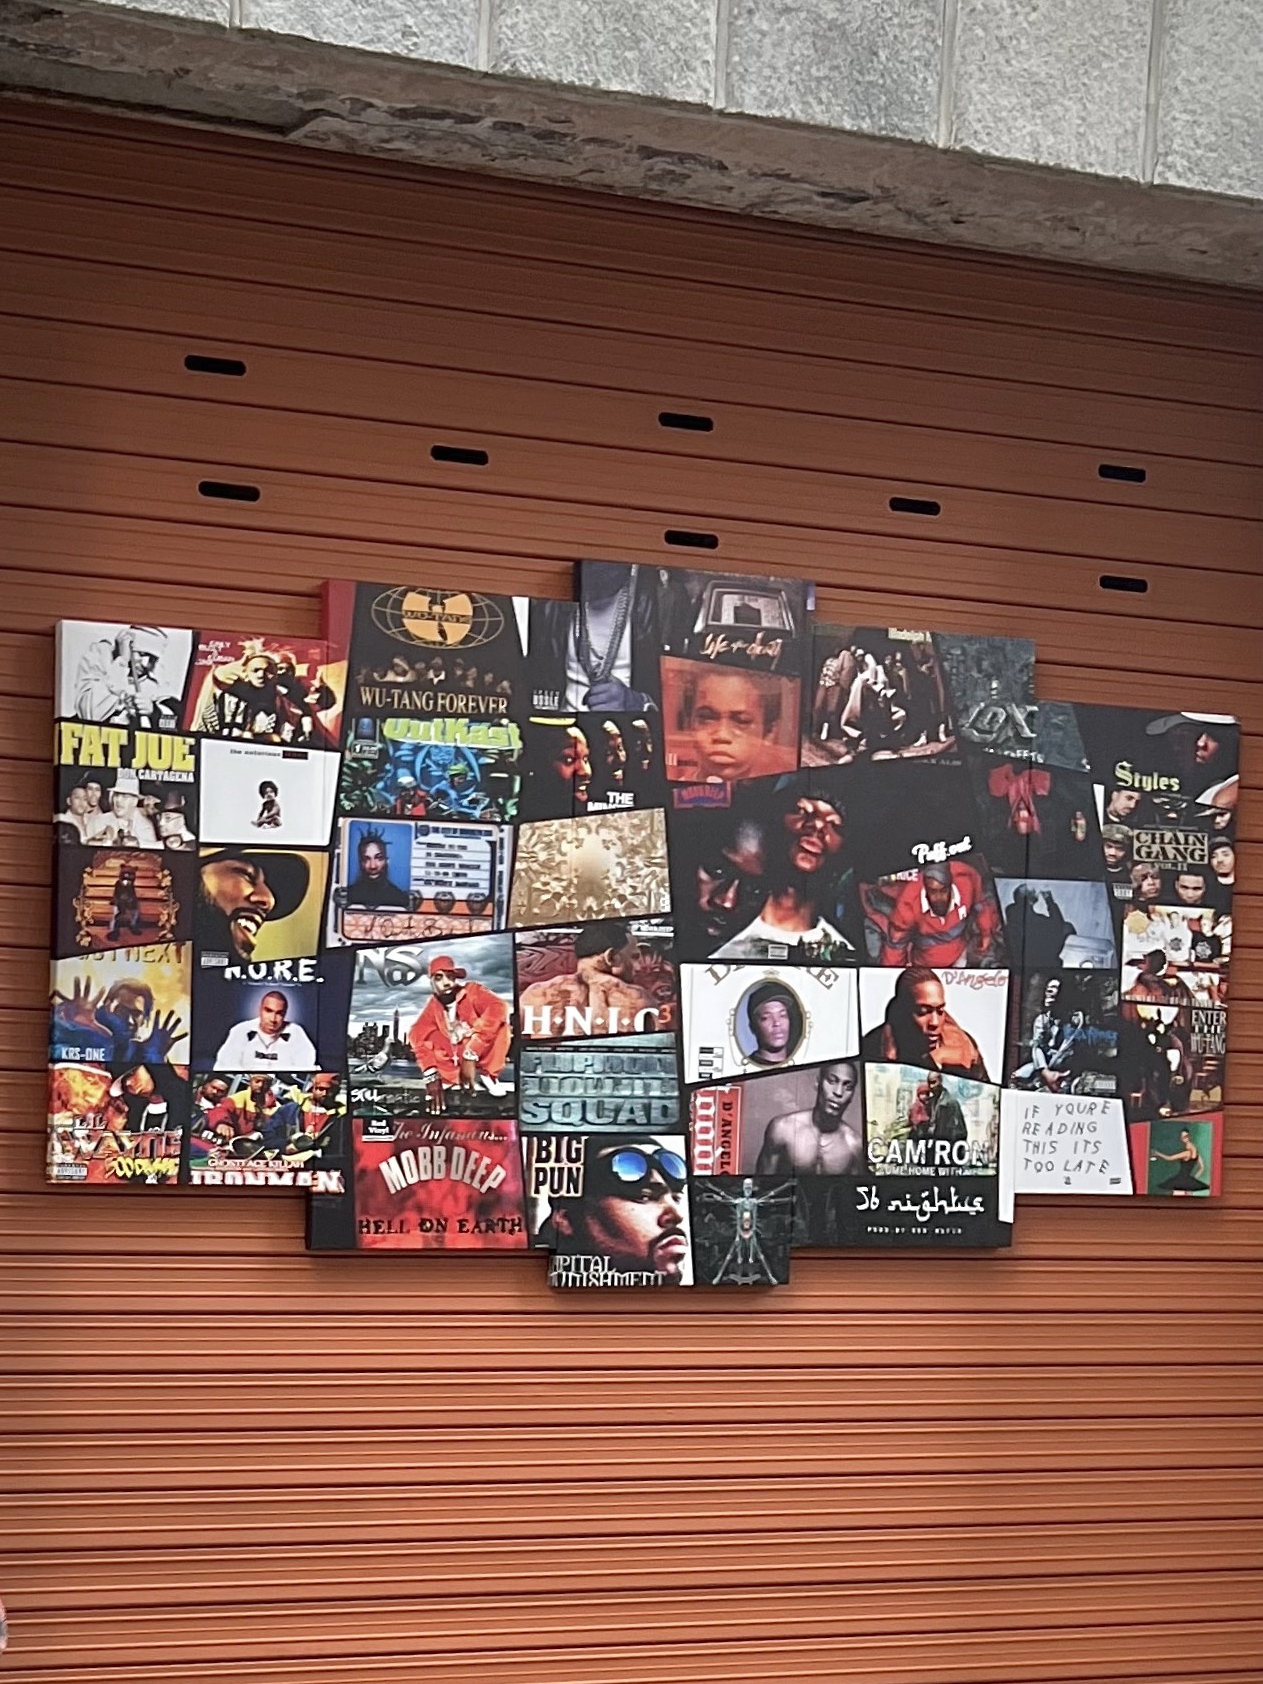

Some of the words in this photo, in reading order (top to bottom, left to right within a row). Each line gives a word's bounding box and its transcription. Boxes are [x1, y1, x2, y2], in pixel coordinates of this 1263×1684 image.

[361, 686, 433, 711] WU-TANG
[61, 722, 128, 768] FAT
[138, 769, 194, 783] CARTAGENA
[1115, 761, 1180, 791] Styles
[606, 791, 634, 804] THE
[1136, 831, 1206, 847] CHAIN
[1135, 845, 1206, 862] GANG
[1191, 1009, 1227, 1025] ENTER
[61, 1047, 105, 1061] KRS-ONE
[1024, 1105, 1040, 1119] IF
[74, 1113, 107, 1129] LIL
[1022, 1121, 1098, 1136] READING
[534, 1137, 586, 1163] BIG
[867, 1137, 988, 1166] CAM'RON
[1023, 1139, 1058, 1155] THIS
[1074, 1140, 1102, 1154] ITS
[269, 1159, 304, 1169] KILLAH
[379, 1146, 446, 1194] MOBB
[450, 1146, 506, 1193] DEEP
[908, 1166, 936, 1176] HOME
[1023, 1157, 1055, 1173] TOO
[1063, 1159, 1110, 1175] LATE
[532, 1166, 583, 1197] PUN
[358, 1217, 410, 1235] HELL
[418, 1217, 448, 1235] ON
[457, 1216, 523, 1236] EARTH
